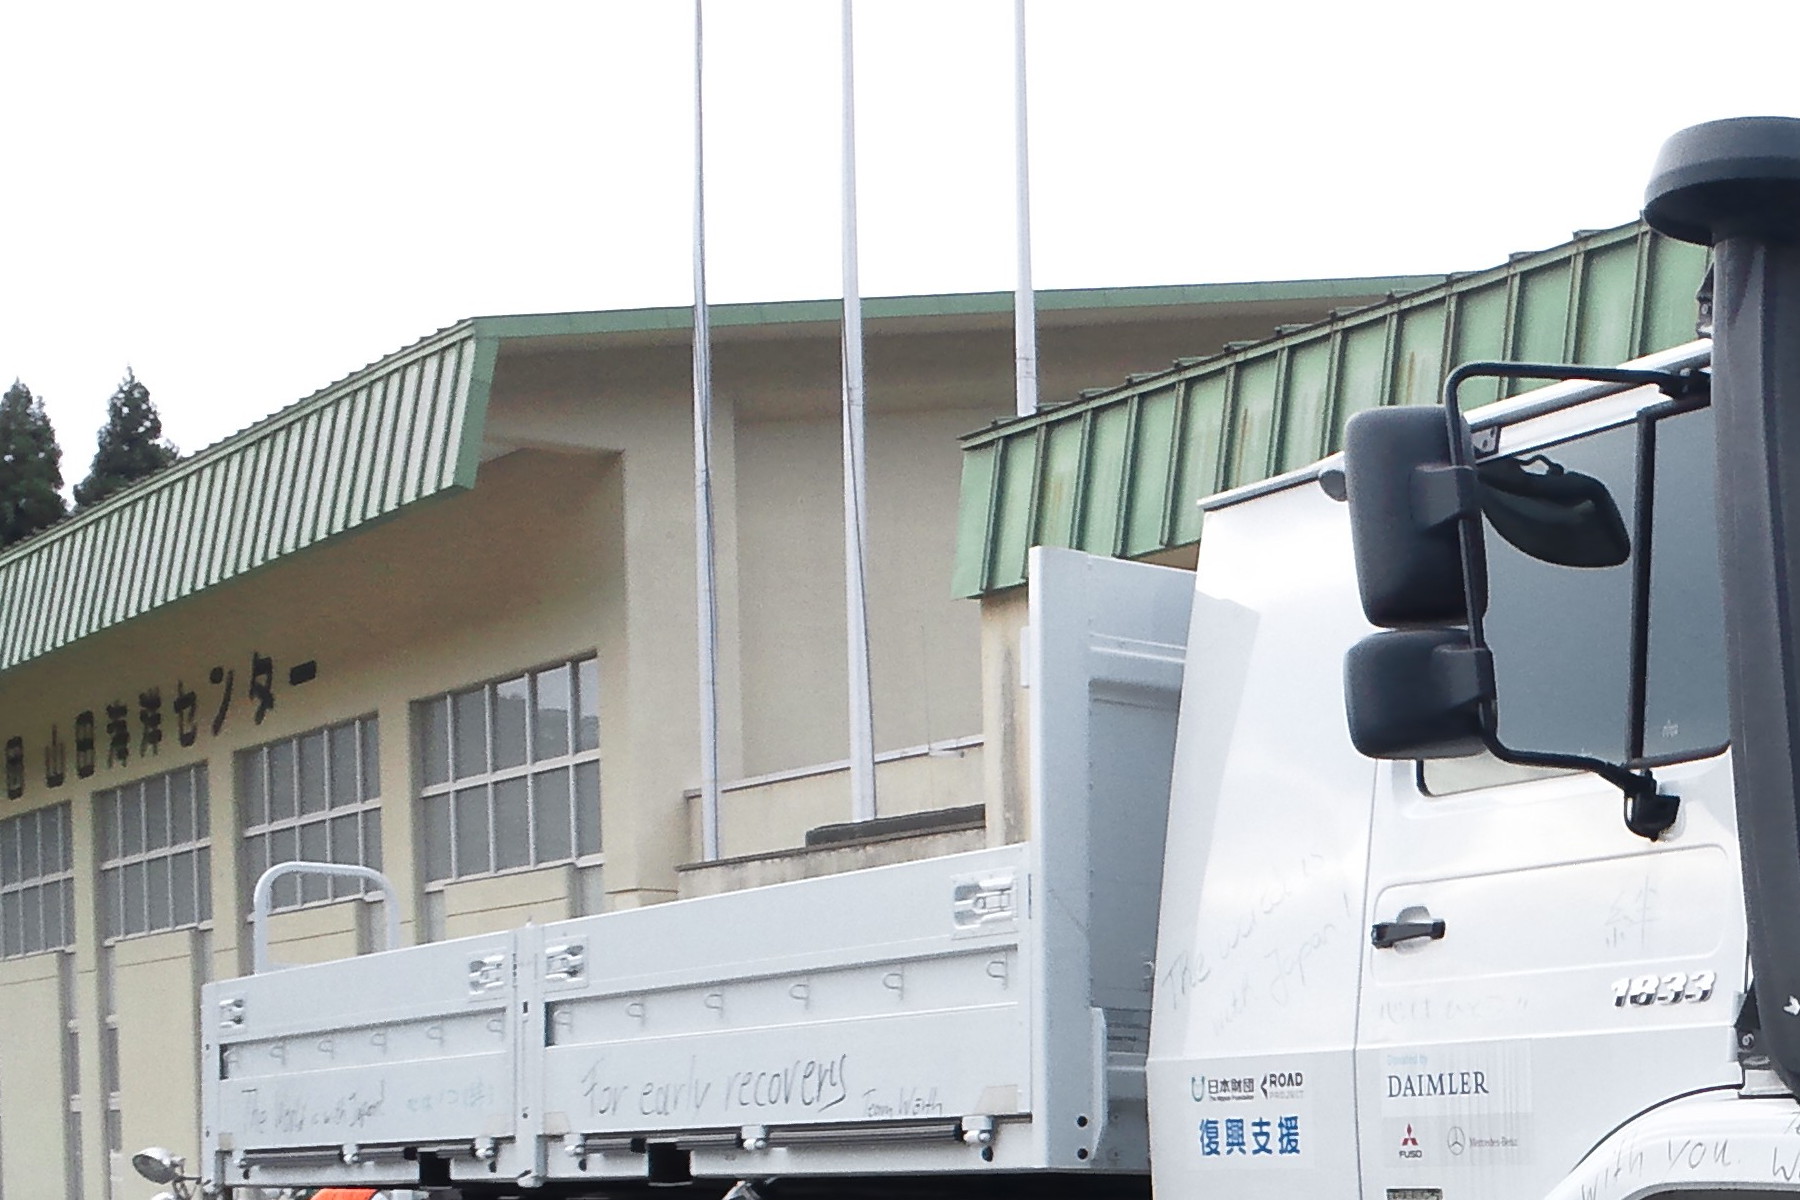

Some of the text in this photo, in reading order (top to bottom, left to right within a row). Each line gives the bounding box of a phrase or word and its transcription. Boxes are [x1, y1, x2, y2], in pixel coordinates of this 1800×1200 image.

[1611, 969, 1717, 1008] 1833
[1269, 1072, 1303, 1088] ROAD
[1388, 1071, 1489, 1098] DAIMLER
[1199, 1116, 1300, 1156] 復興支援
[1399, 1150, 1422, 1159] FUSO
